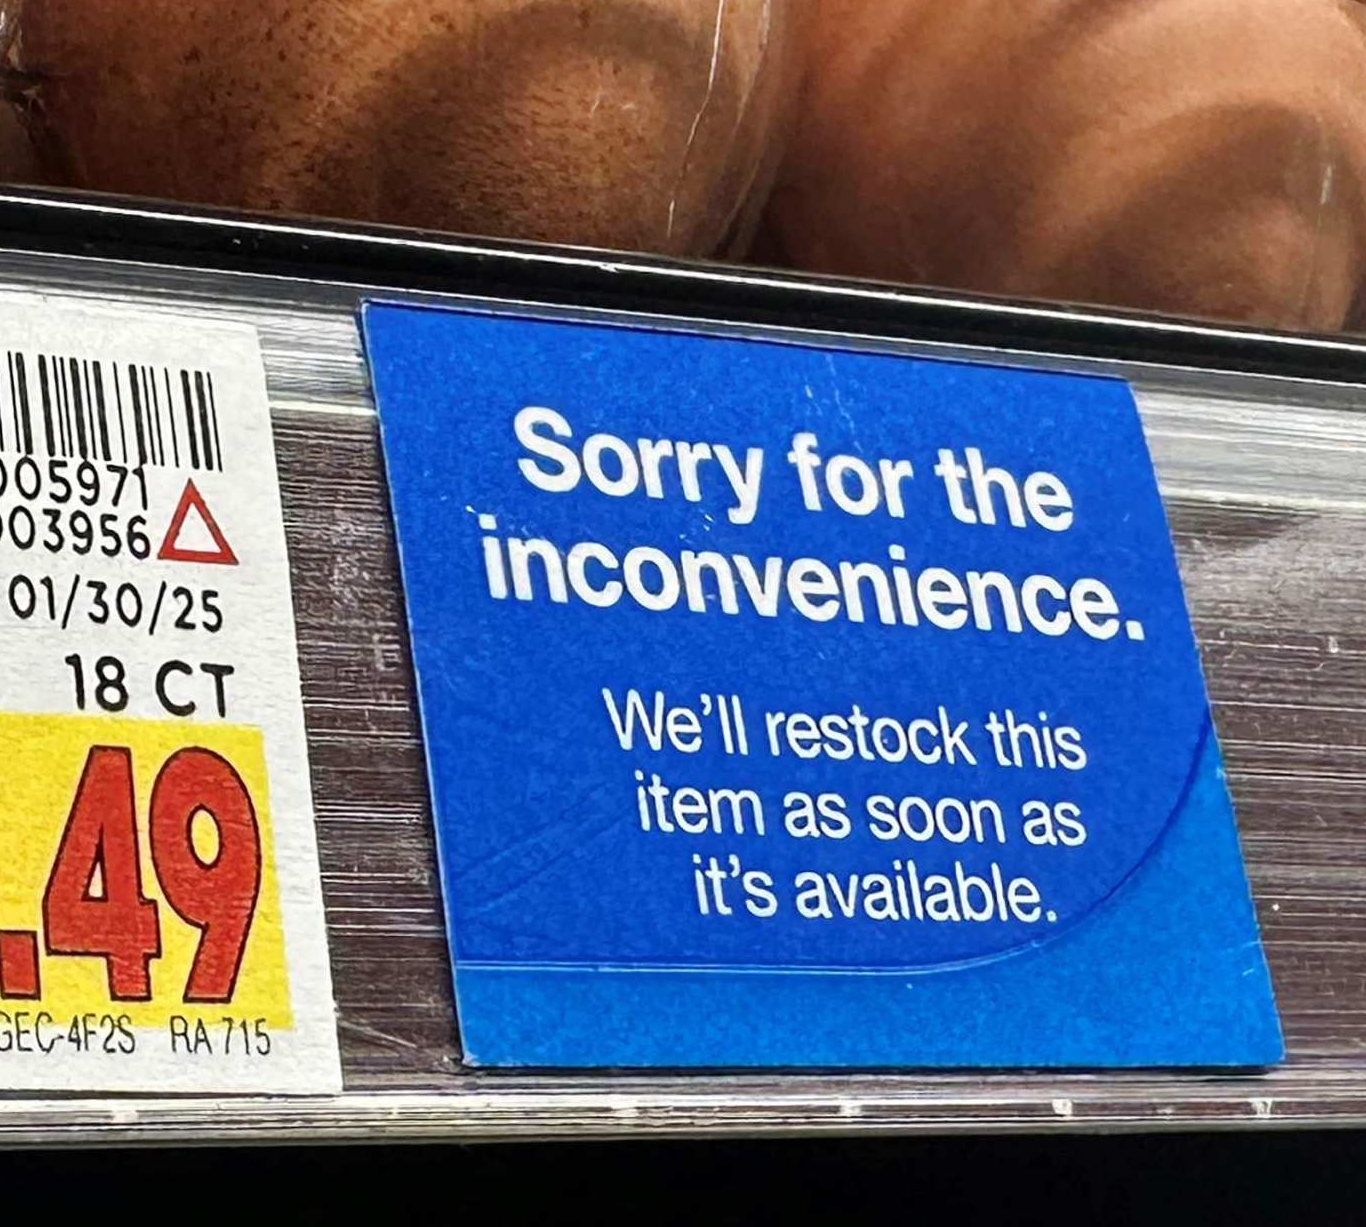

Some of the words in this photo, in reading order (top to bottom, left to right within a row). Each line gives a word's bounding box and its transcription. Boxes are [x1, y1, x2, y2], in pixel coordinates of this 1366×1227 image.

[512, 405, 764, 525] Sorry
[787, 430, 915, 520] for
[935, 447, 1074, 532] the
[8, 573, 225, 636] 01/30/25
[480, 514, 1146, 643] inconvenience.
[67, 655, 130, 713] 18
[155, 661, 235, 718] CT
[601, 686, 748, 758] We'll
[764, 702, 977, 768] restock
[985, 707, 1088, 772] this
[635, 771, 765, 837] item
[784, 790, 851, 840] as
[865, 793, 1006, 846] soon
[1022, 797, 1088, 848] as
[693, 853, 779, 920] it's
[792, 860, 1059, 925] available.
[170, 1016, 211, 1052] RA
[220, 1017, 272, 1056] 715
